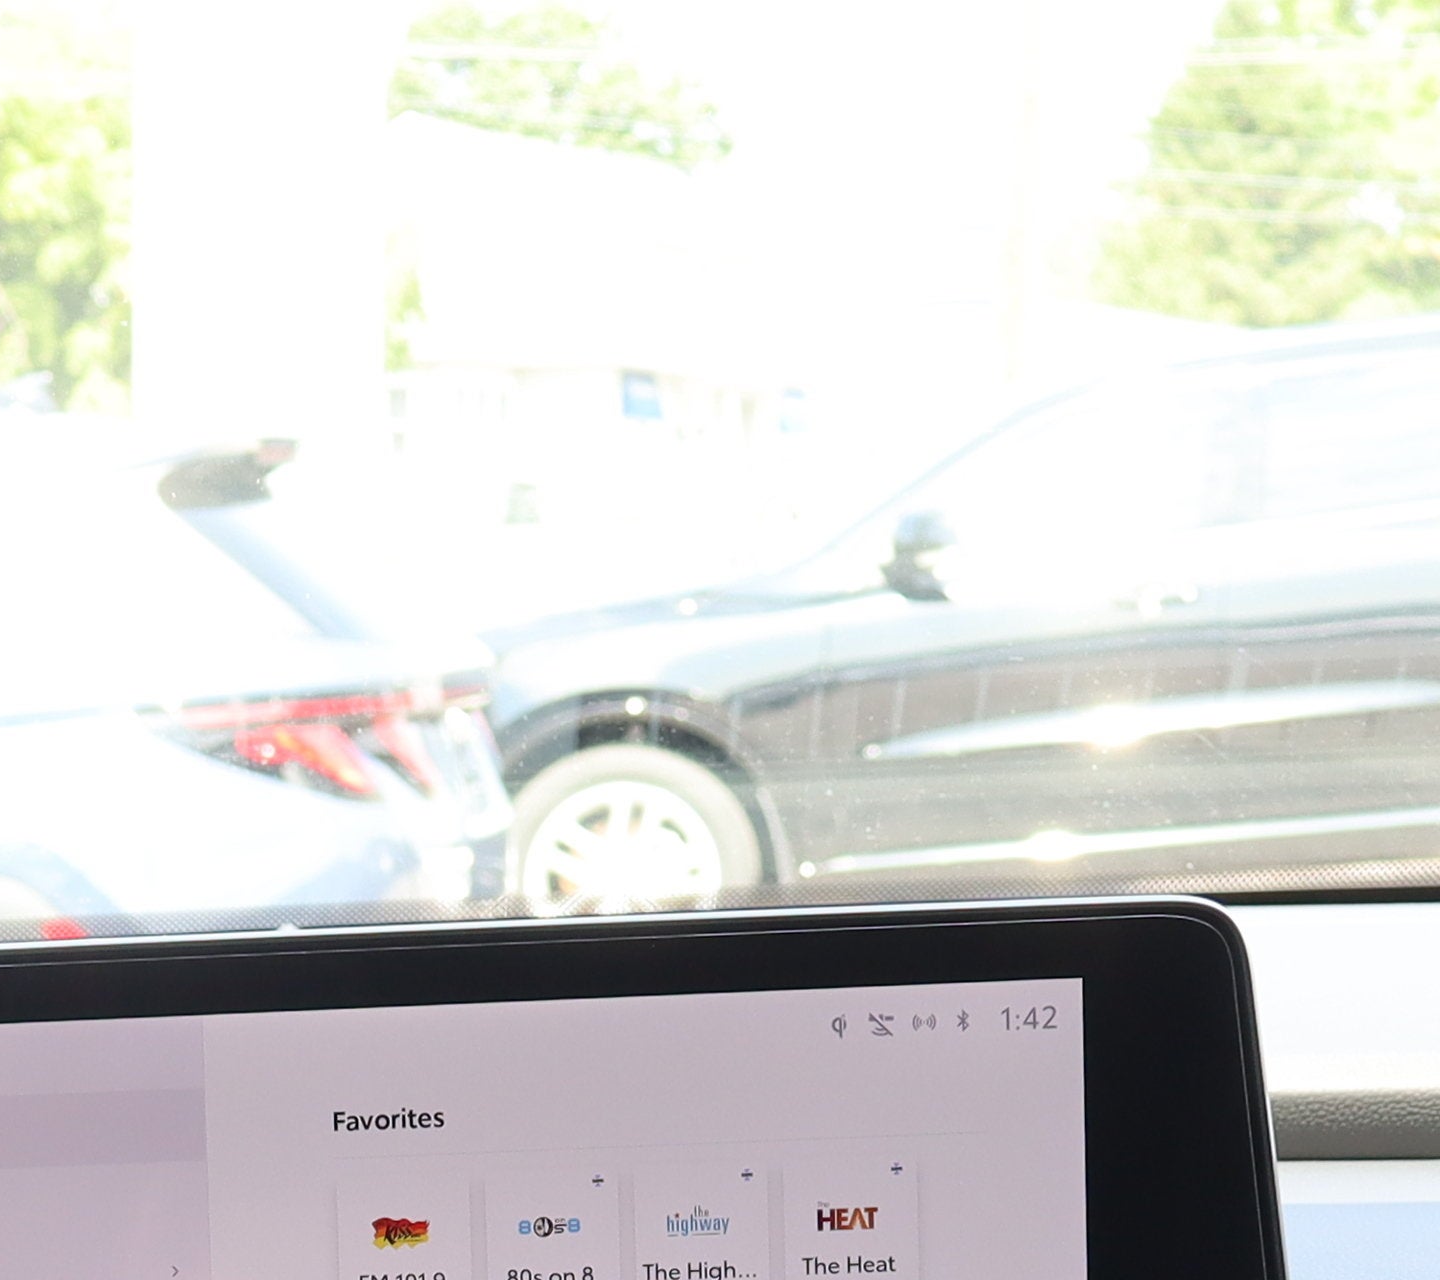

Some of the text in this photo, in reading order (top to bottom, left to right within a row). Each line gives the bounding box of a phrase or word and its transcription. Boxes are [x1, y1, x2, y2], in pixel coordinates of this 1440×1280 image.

[1000, 1005, 1059, 1033] 1:42
[332, 1106, 446, 1132] Favorites
[666, 1213, 730, 1237] highway
[816, 1207, 878, 1231] HEAT
[802, 1255, 896, 1275] The Heat
